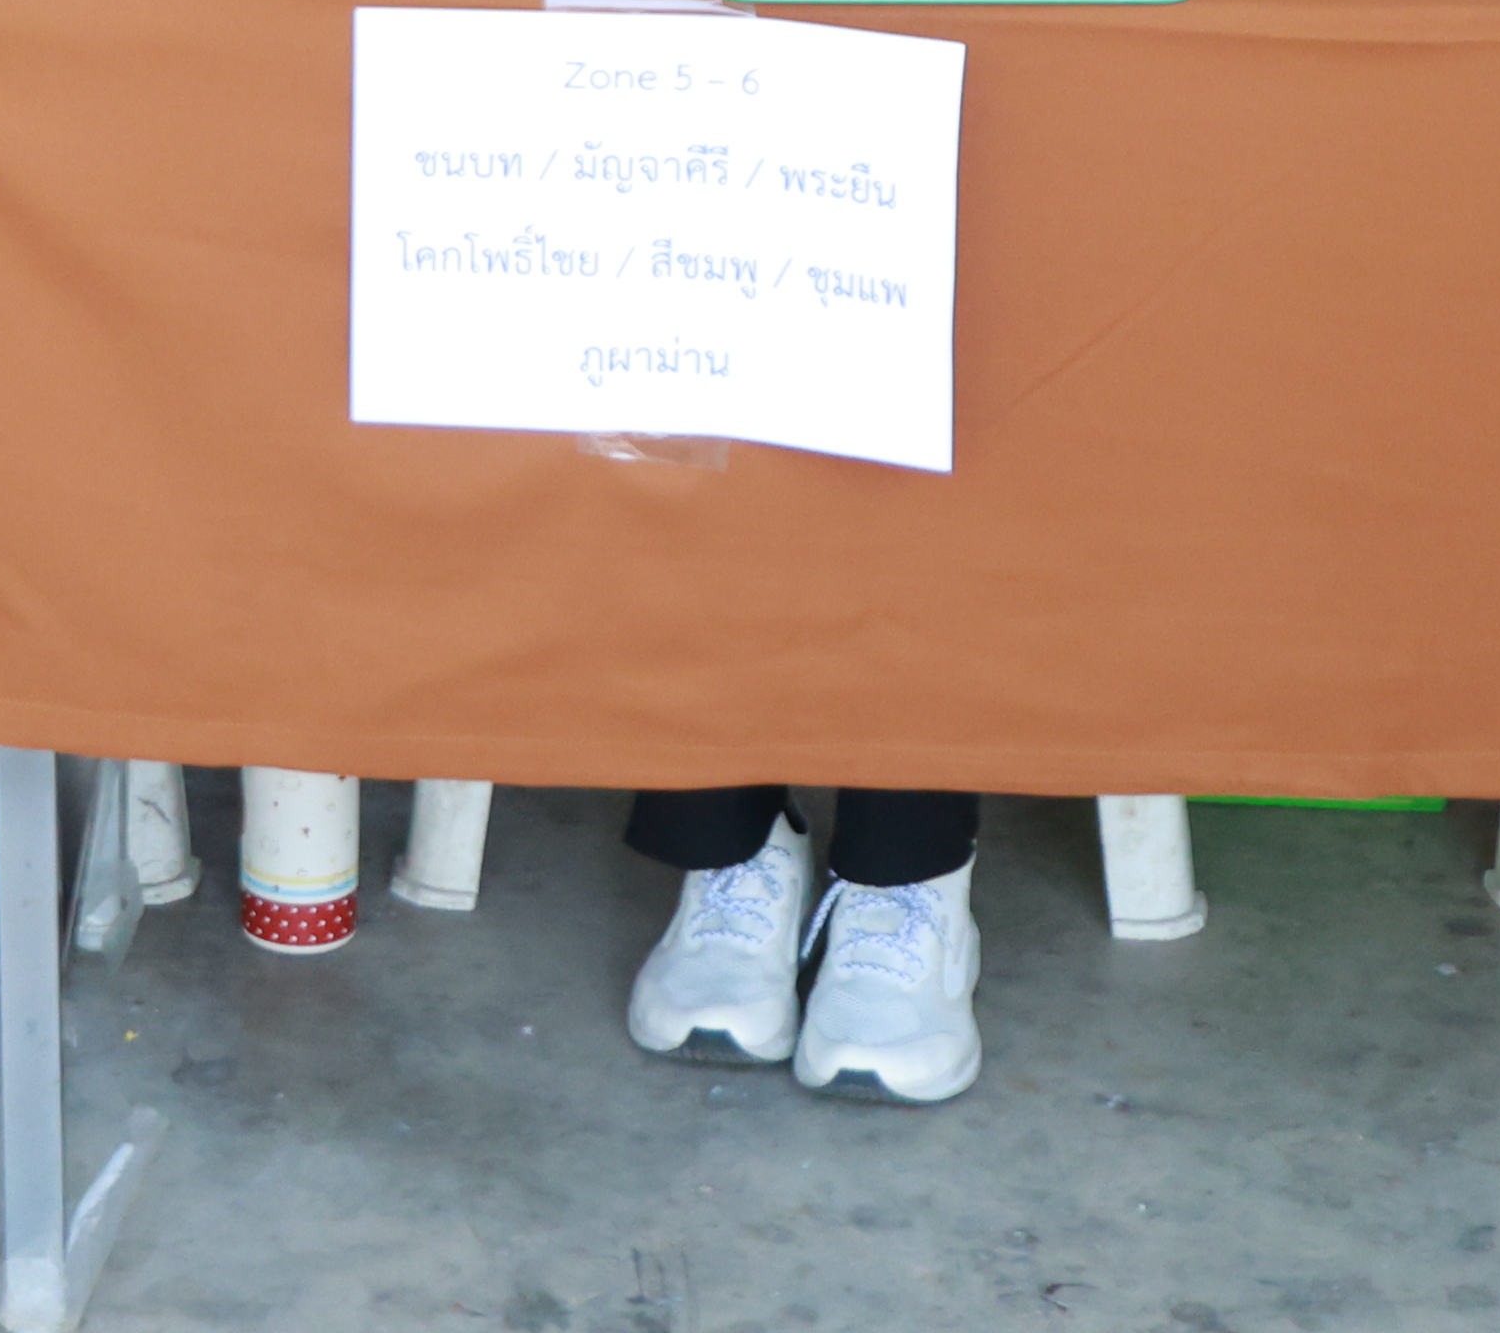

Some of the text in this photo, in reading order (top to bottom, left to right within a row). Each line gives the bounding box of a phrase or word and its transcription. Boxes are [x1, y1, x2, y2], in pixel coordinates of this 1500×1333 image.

[562, 60, 658, 92] Zone
[674, 63, 693, 93] 5
[740, 68, 760, 97] 6
[413, 150, 523, 179] ชนบท
[778, 161, 897, 210] พระยืน
[650, 237, 758, 300] สีชมพู
[806, 265, 908, 309] ชุมแพ
[578, 336, 730, 388] ภูผาม่าน
